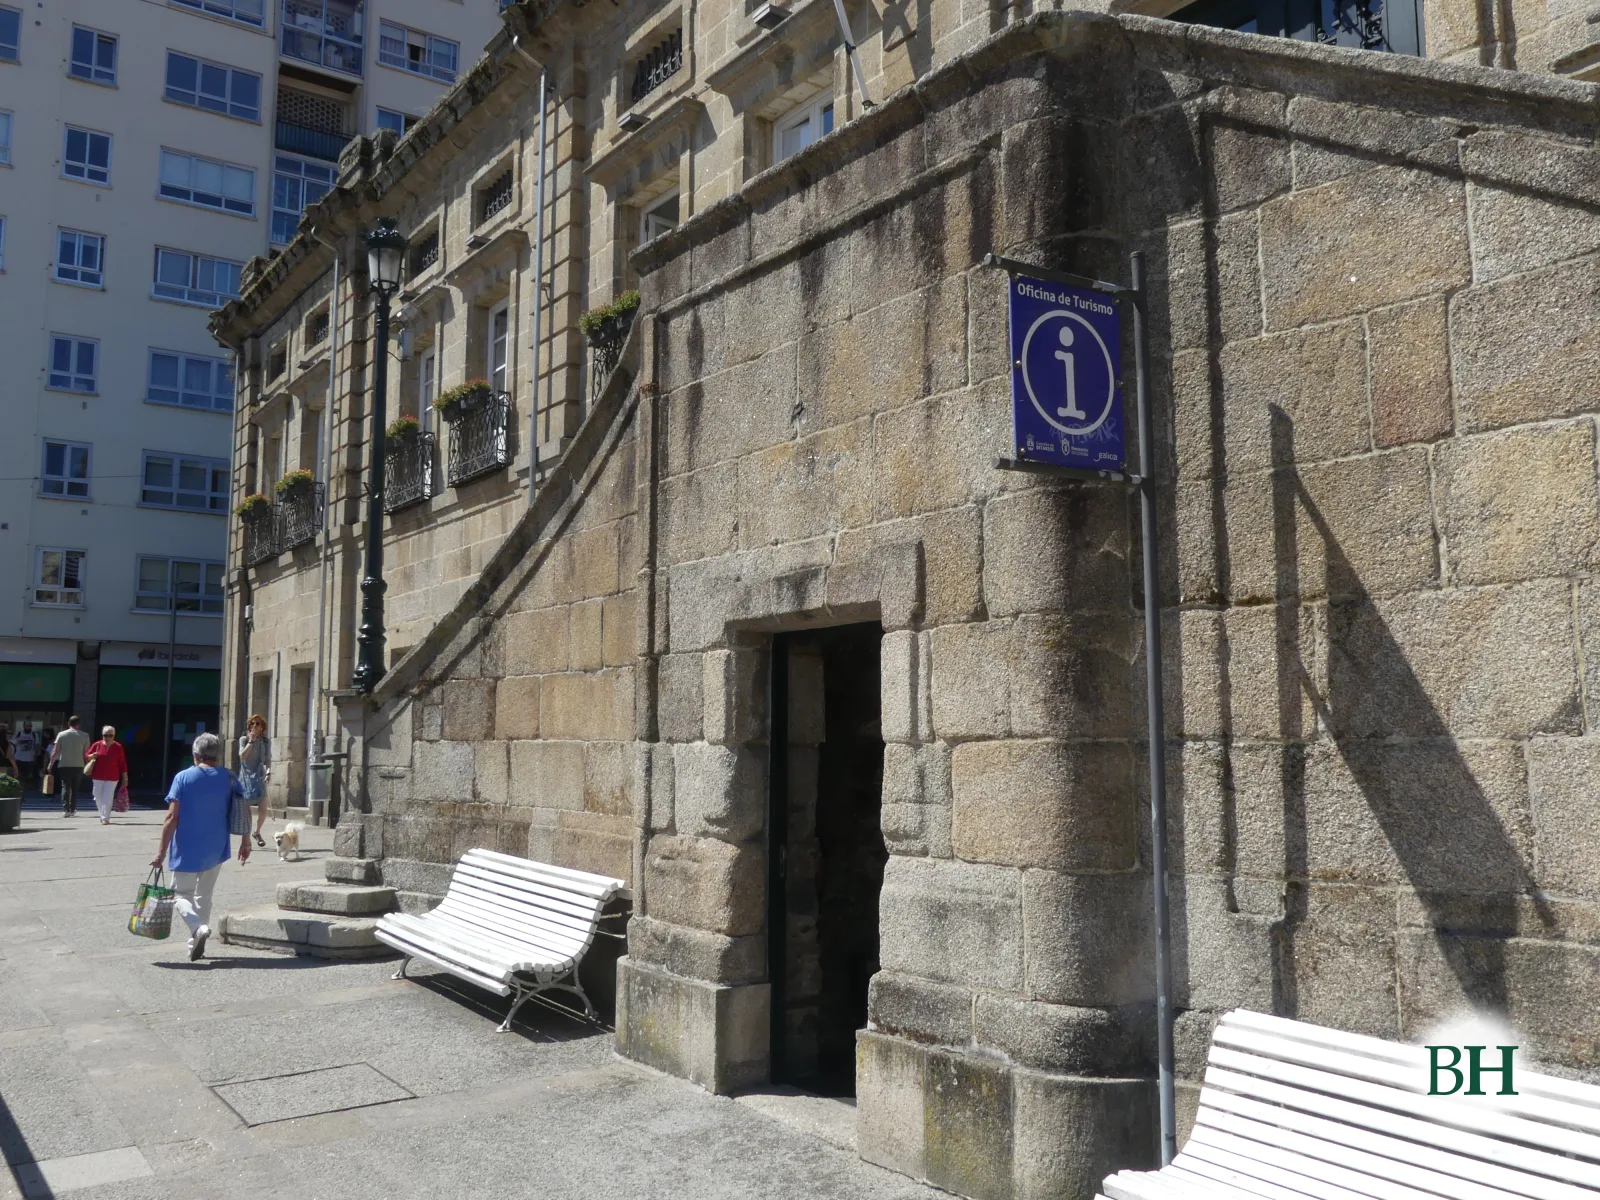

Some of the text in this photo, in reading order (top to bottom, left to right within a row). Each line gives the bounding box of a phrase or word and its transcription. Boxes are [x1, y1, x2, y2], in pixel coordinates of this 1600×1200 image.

[1017, 283, 1113, 315] Oficina de Turismo
[1093, 452, 1118, 462] galicia
[157, 653, 199, 661] Ibedrola
